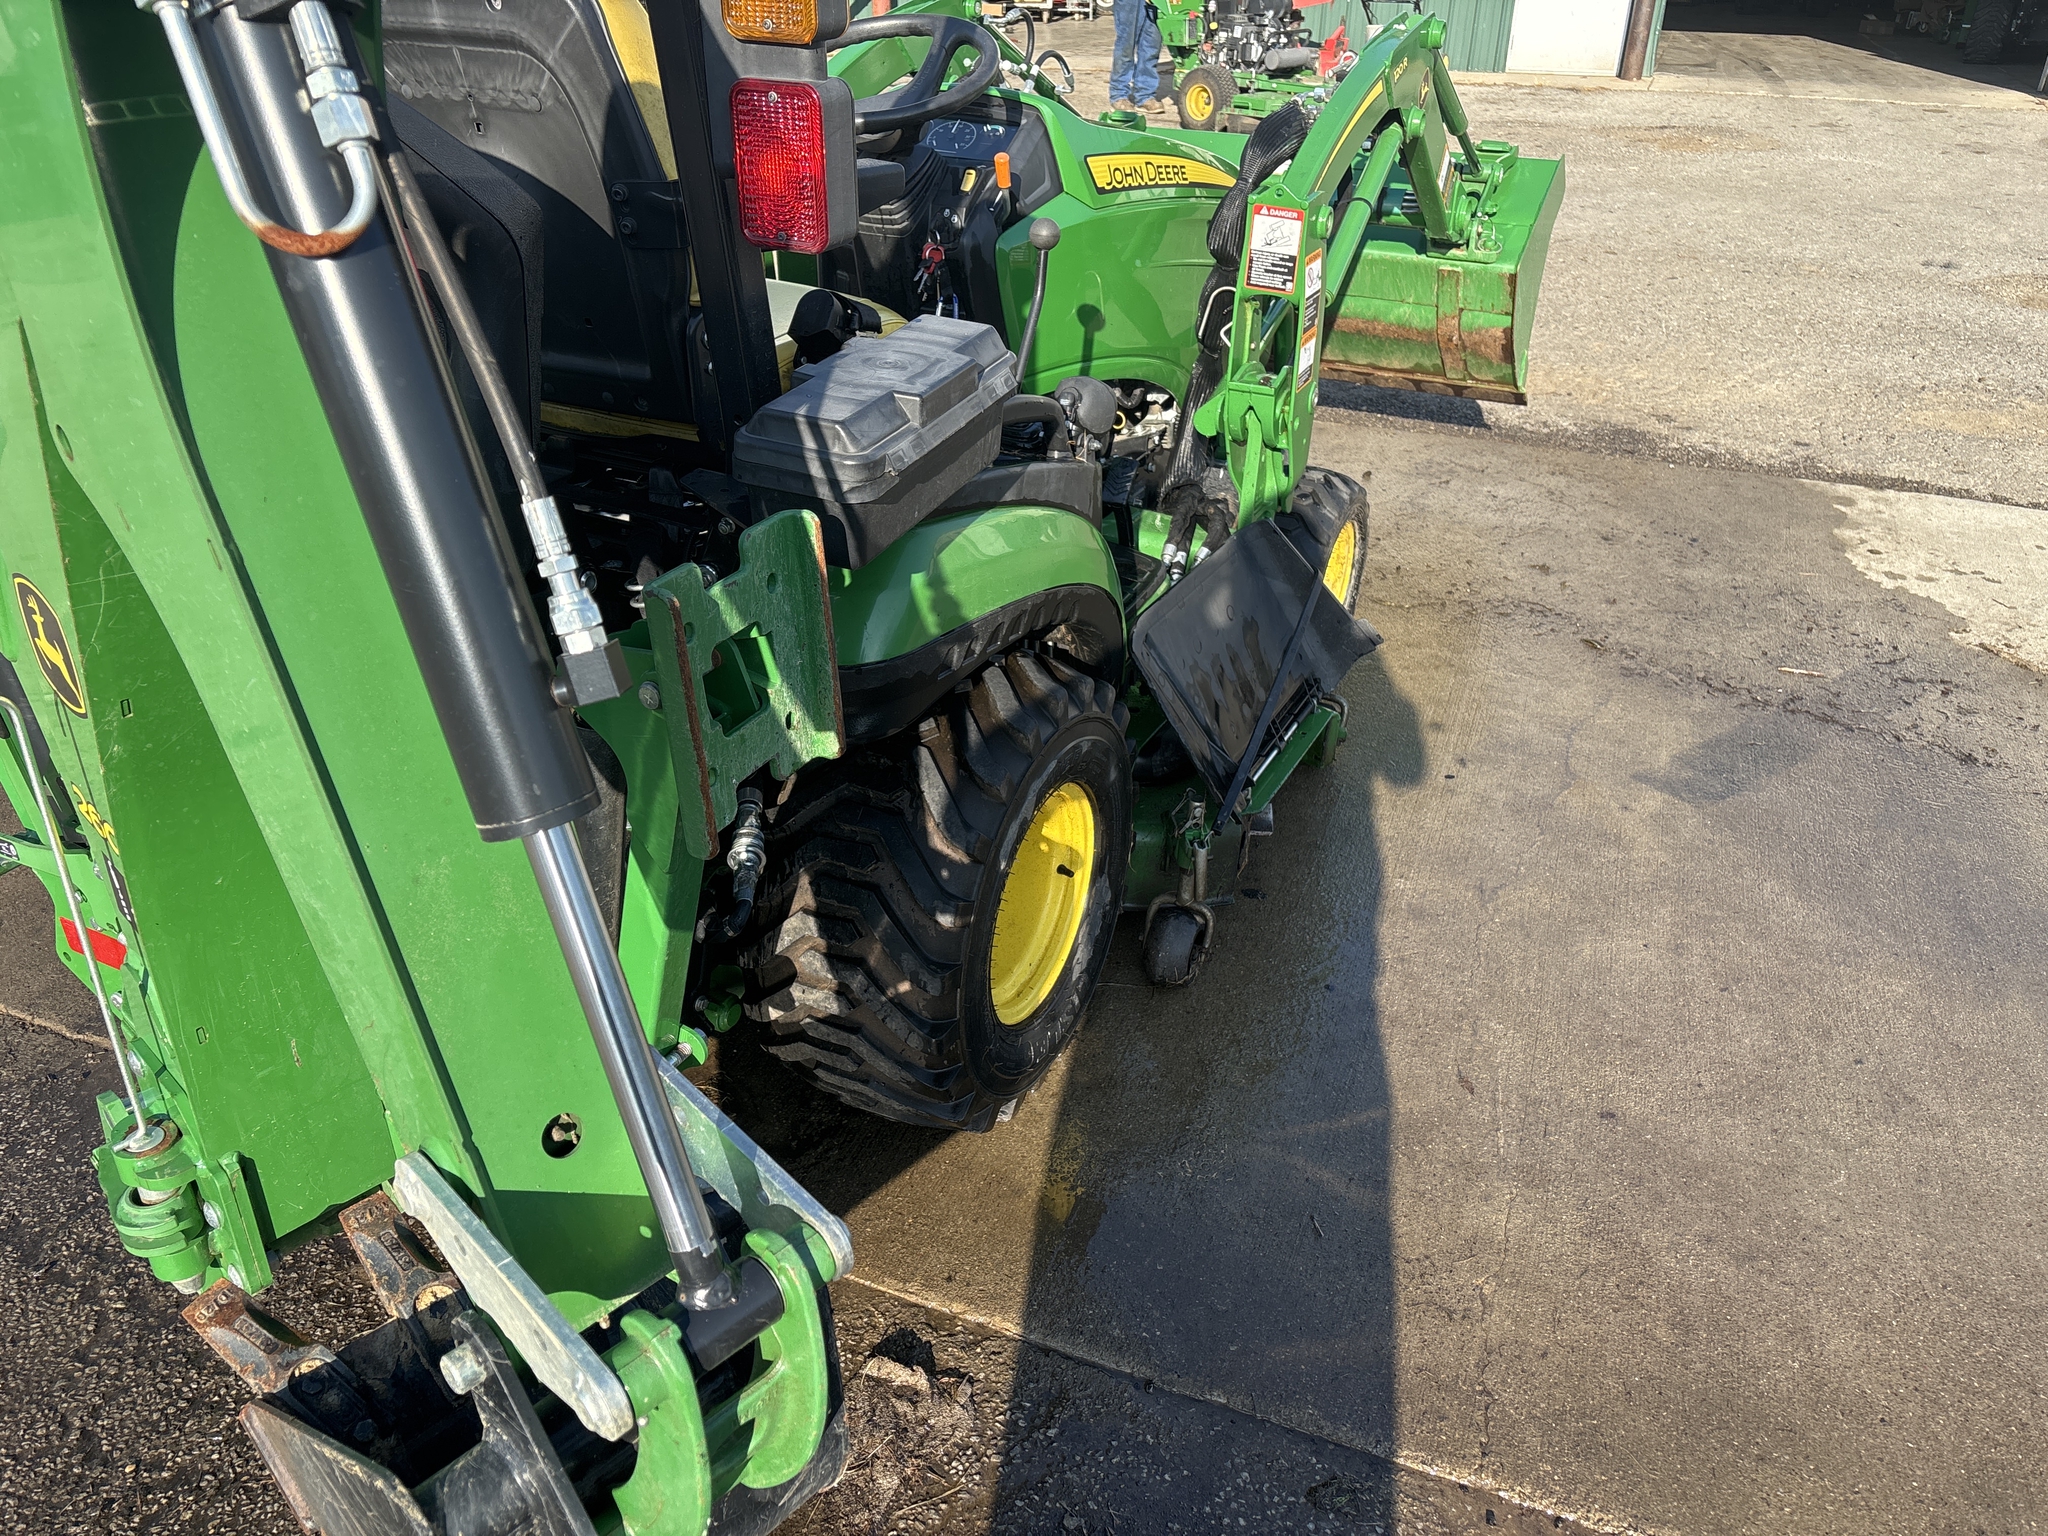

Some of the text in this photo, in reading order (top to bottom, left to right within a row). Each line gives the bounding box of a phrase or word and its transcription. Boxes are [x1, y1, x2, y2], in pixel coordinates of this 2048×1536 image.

[1105, 161, 1189, 187] JOHN DEERE
[1269, 208, 1299, 220] DANGER
